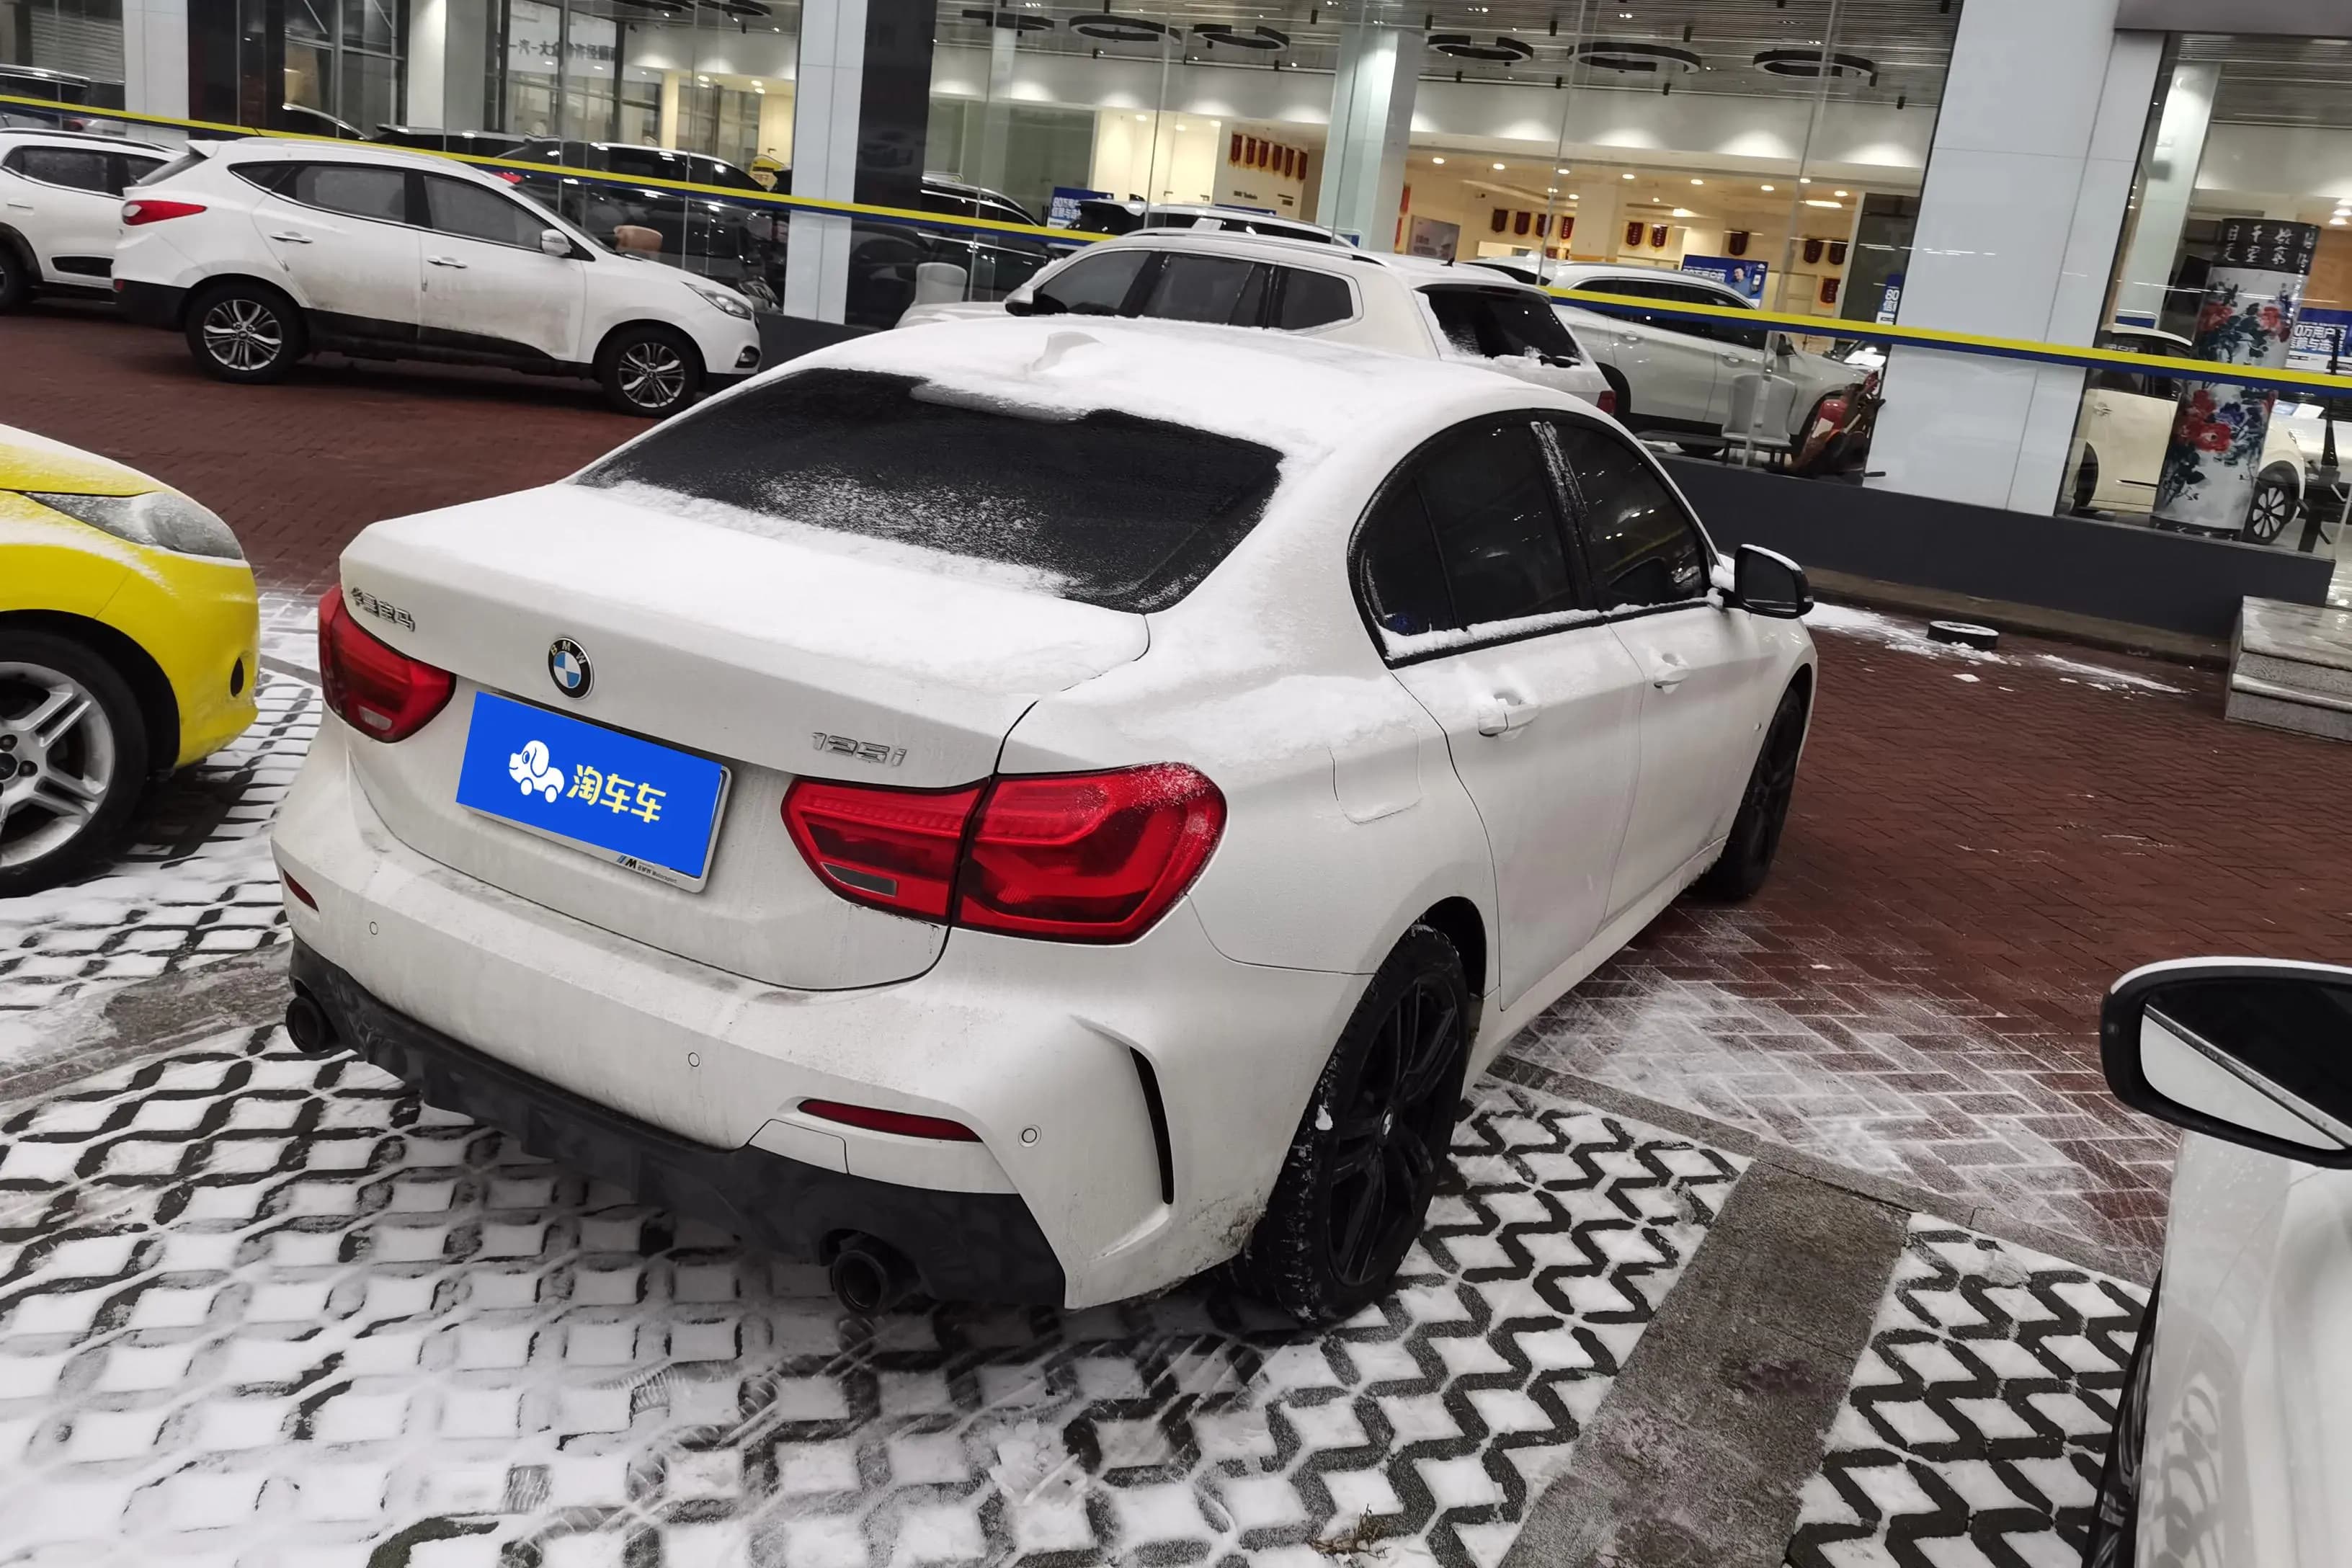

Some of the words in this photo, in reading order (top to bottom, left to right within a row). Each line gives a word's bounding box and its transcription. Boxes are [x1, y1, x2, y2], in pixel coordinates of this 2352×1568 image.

[351, 587, 416, 632] 华晨宝马
[550, 641, 587, 664] BMW
[812, 732, 907, 767] 125i
